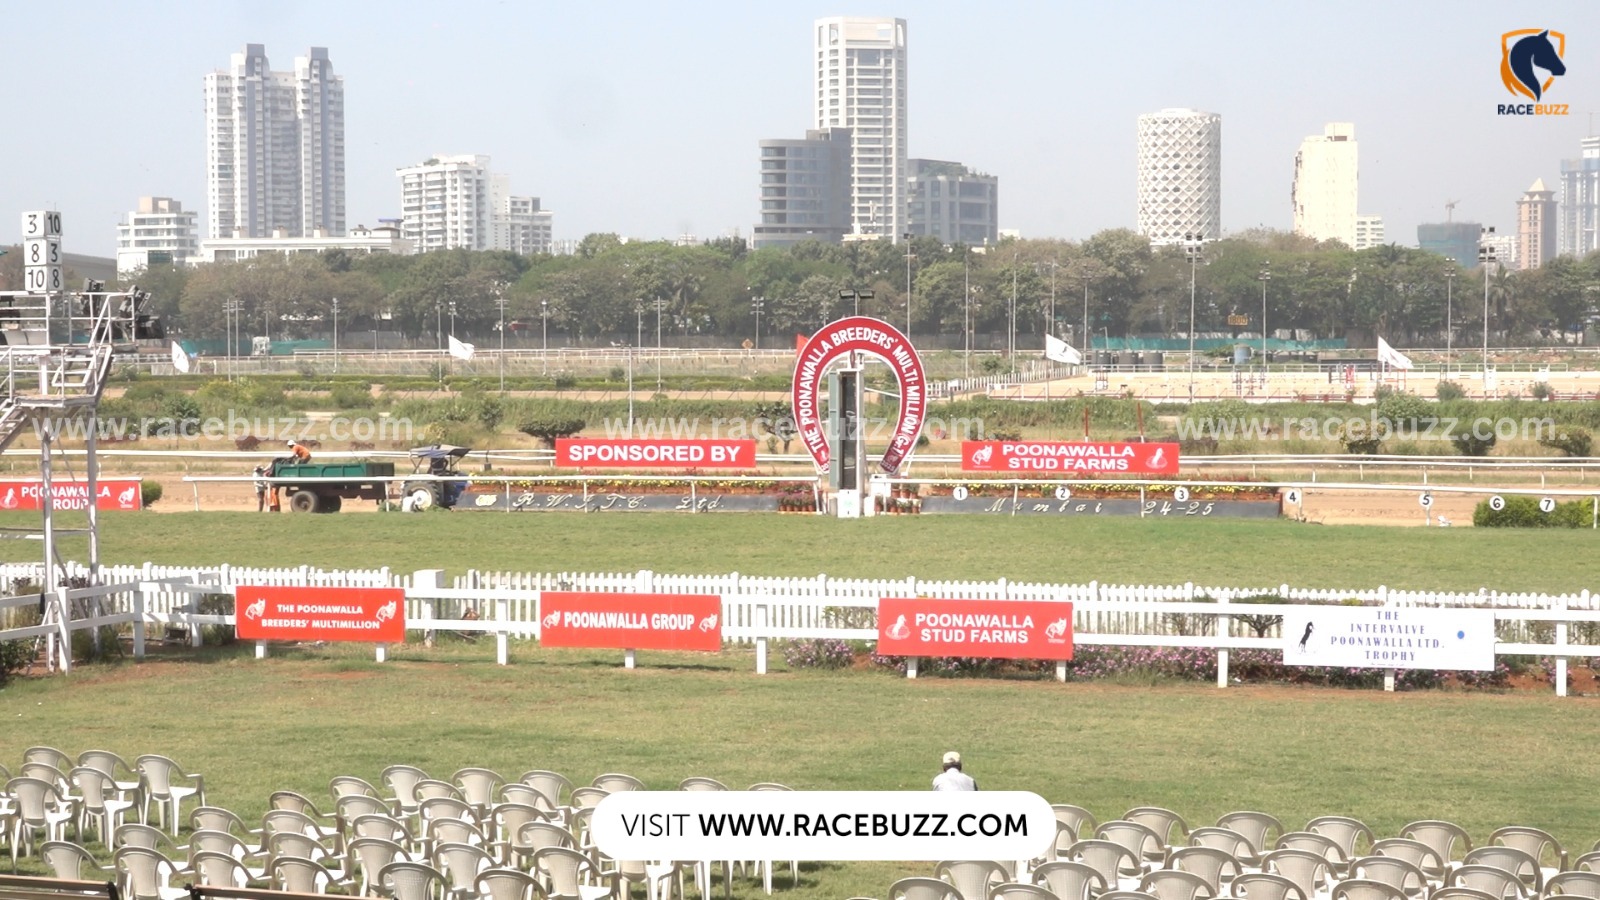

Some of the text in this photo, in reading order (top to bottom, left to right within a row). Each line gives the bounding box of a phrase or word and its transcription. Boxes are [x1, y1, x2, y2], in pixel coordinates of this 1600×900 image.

[28, 214, 37, 234] 3
[48, 214, 60, 234] 10
[31, 243, 40, 263] 8
[50, 243, 58, 262] 3
[28, 269, 44, 288] 10
[52, 268, 60, 288] 8
[830, 326, 899, 350] BREEDERS'
[798, 340, 834, 426] POONAWALLA
[804, 427, 825, 453] THE
[569, 445, 740, 462] SPONSORED BY
[1002, 444, 1135, 457] POONAWALLA
[1008, 457, 1129, 471] STUD FARMS
[1059, 488, 1066, 498] 2
[1178, 489, 1185, 499] 3
[1288, 491, 1297, 502] 4
[1422, 494, 1430, 506] 5
[1142, 500, 1215, 516] 24-25
[1493, 497, 1501, 509] 6
[1544, 499, 1552, 511] 7
[277, 604, 363, 614] THE POONAWALLA
[1377, 610, 1399, 621] THE
[261, 619, 380, 629] BREEDERS' MULTIMILLION
[563, 611, 695, 630] POONAWALLA GROUP
[915, 613, 1035, 629] POONAWALLA
[920, 628, 1029, 644] STUD FARMS
[1350, 623, 1425, 635] INTERVALVE
[1330, 636, 1445, 649] POONAWALLA LTD.
[1365, 650, 1416, 662] TROPHY
